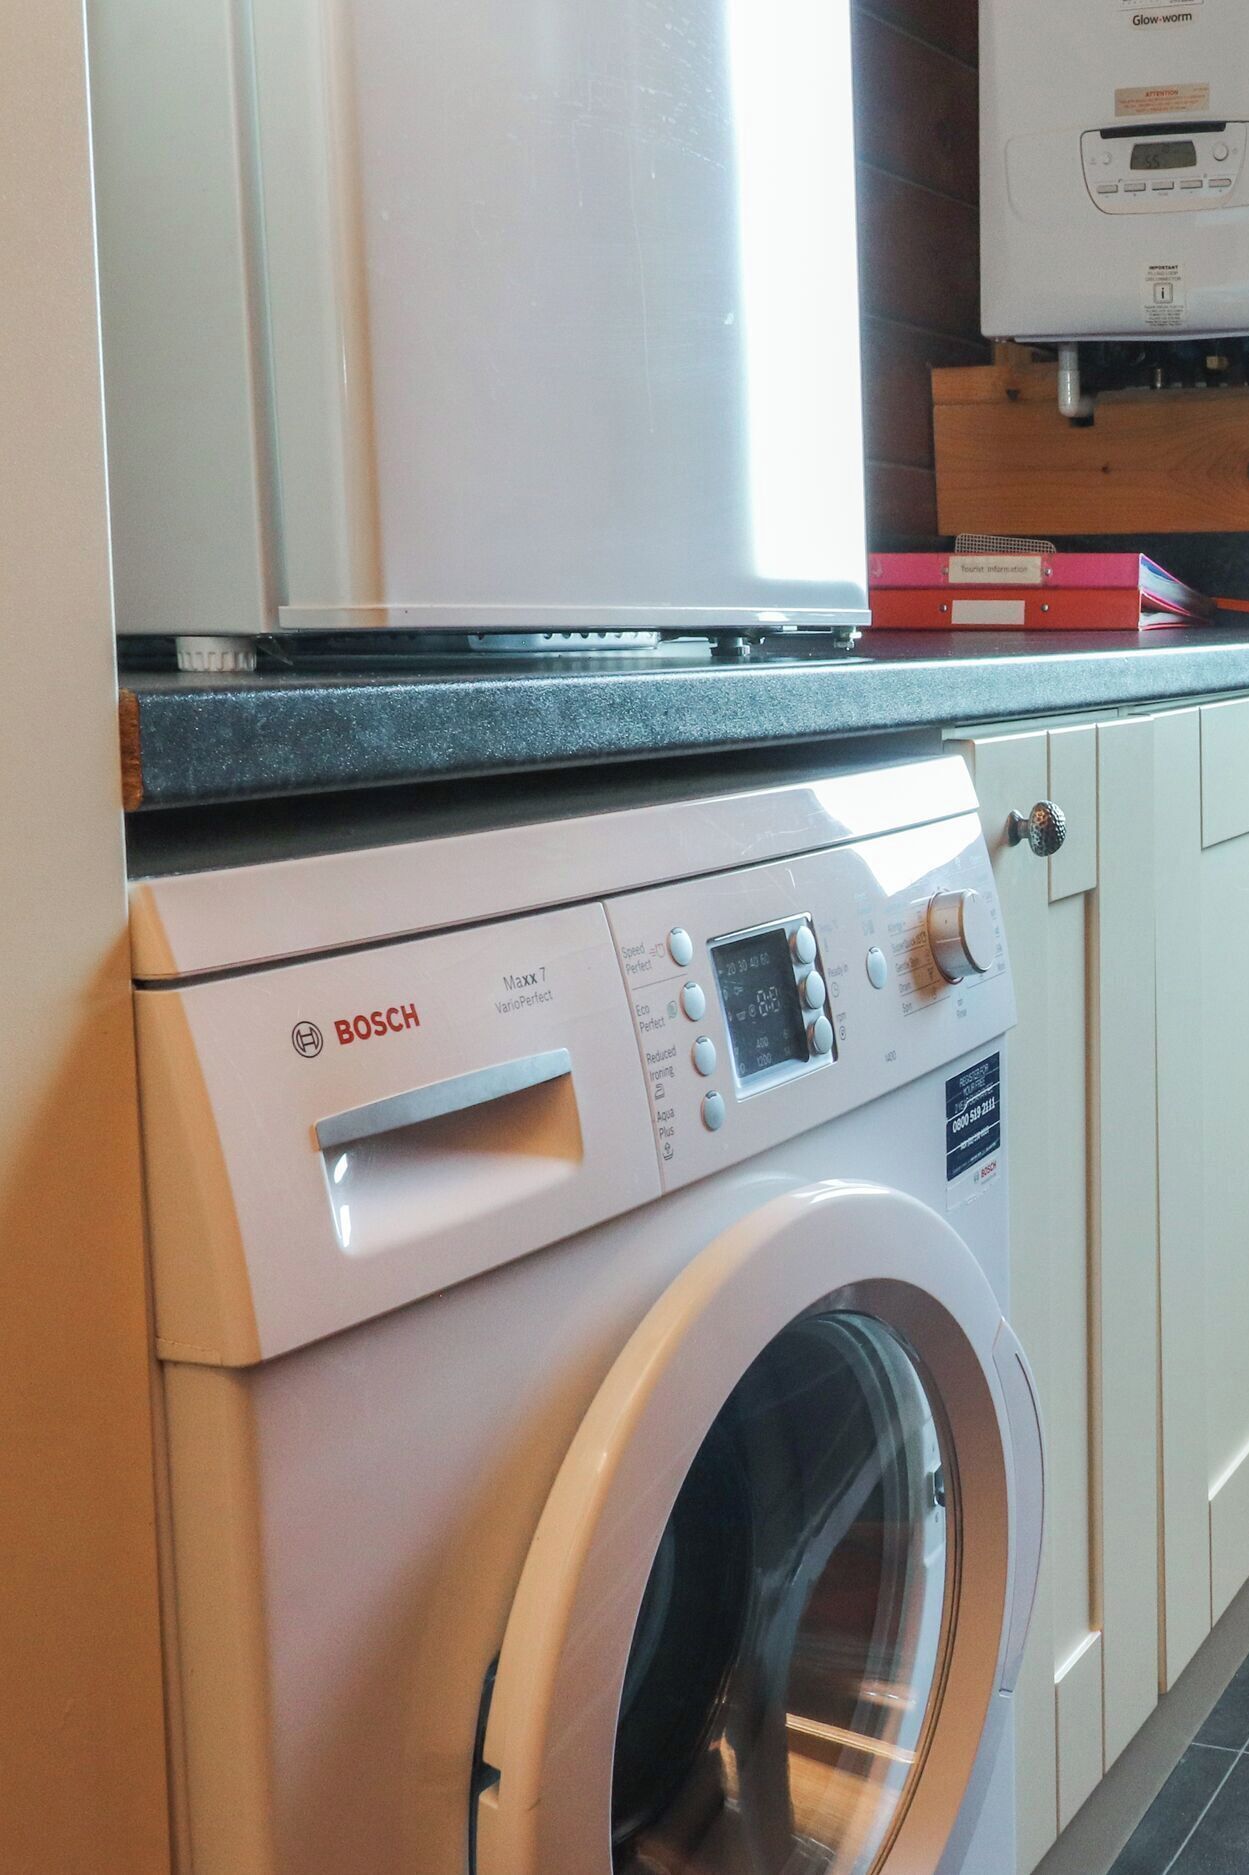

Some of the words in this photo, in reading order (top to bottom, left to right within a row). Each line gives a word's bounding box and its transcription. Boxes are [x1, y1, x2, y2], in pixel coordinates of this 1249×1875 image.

[1132, 13, 1192, 26] Glow-worm
[1145, 89, 1178, 97] ATTENTION
[961, 565, 984, 573] Tourist
[621, 941, 645, 959] Speed
[626, 960, 652, 974] Perfect
[503, 971, 538, 991] Maxx
[539, 967, 547, 983] 7
[495, 990, 553, 1014] VarioPerfect
[636, 1004, 650, 1016] Eco
[334, 1003, 420, 1045] BOSCH
[639, 1017, 666, 1034] Perfect
[646, 1044, 677, 1064] Reduced
[650, 1065, 675, 1081] Ironing
[657, 1108, 675, 1122] Aqua
[952, 1115, 969, 1134] 0800
[970, 1106, 981, 1123] 519
[981, 1096, 996, 1115] 2111
[659, 1126, 675, 1139] Plus
[980, 1160, 997, 1178] BOSCH
